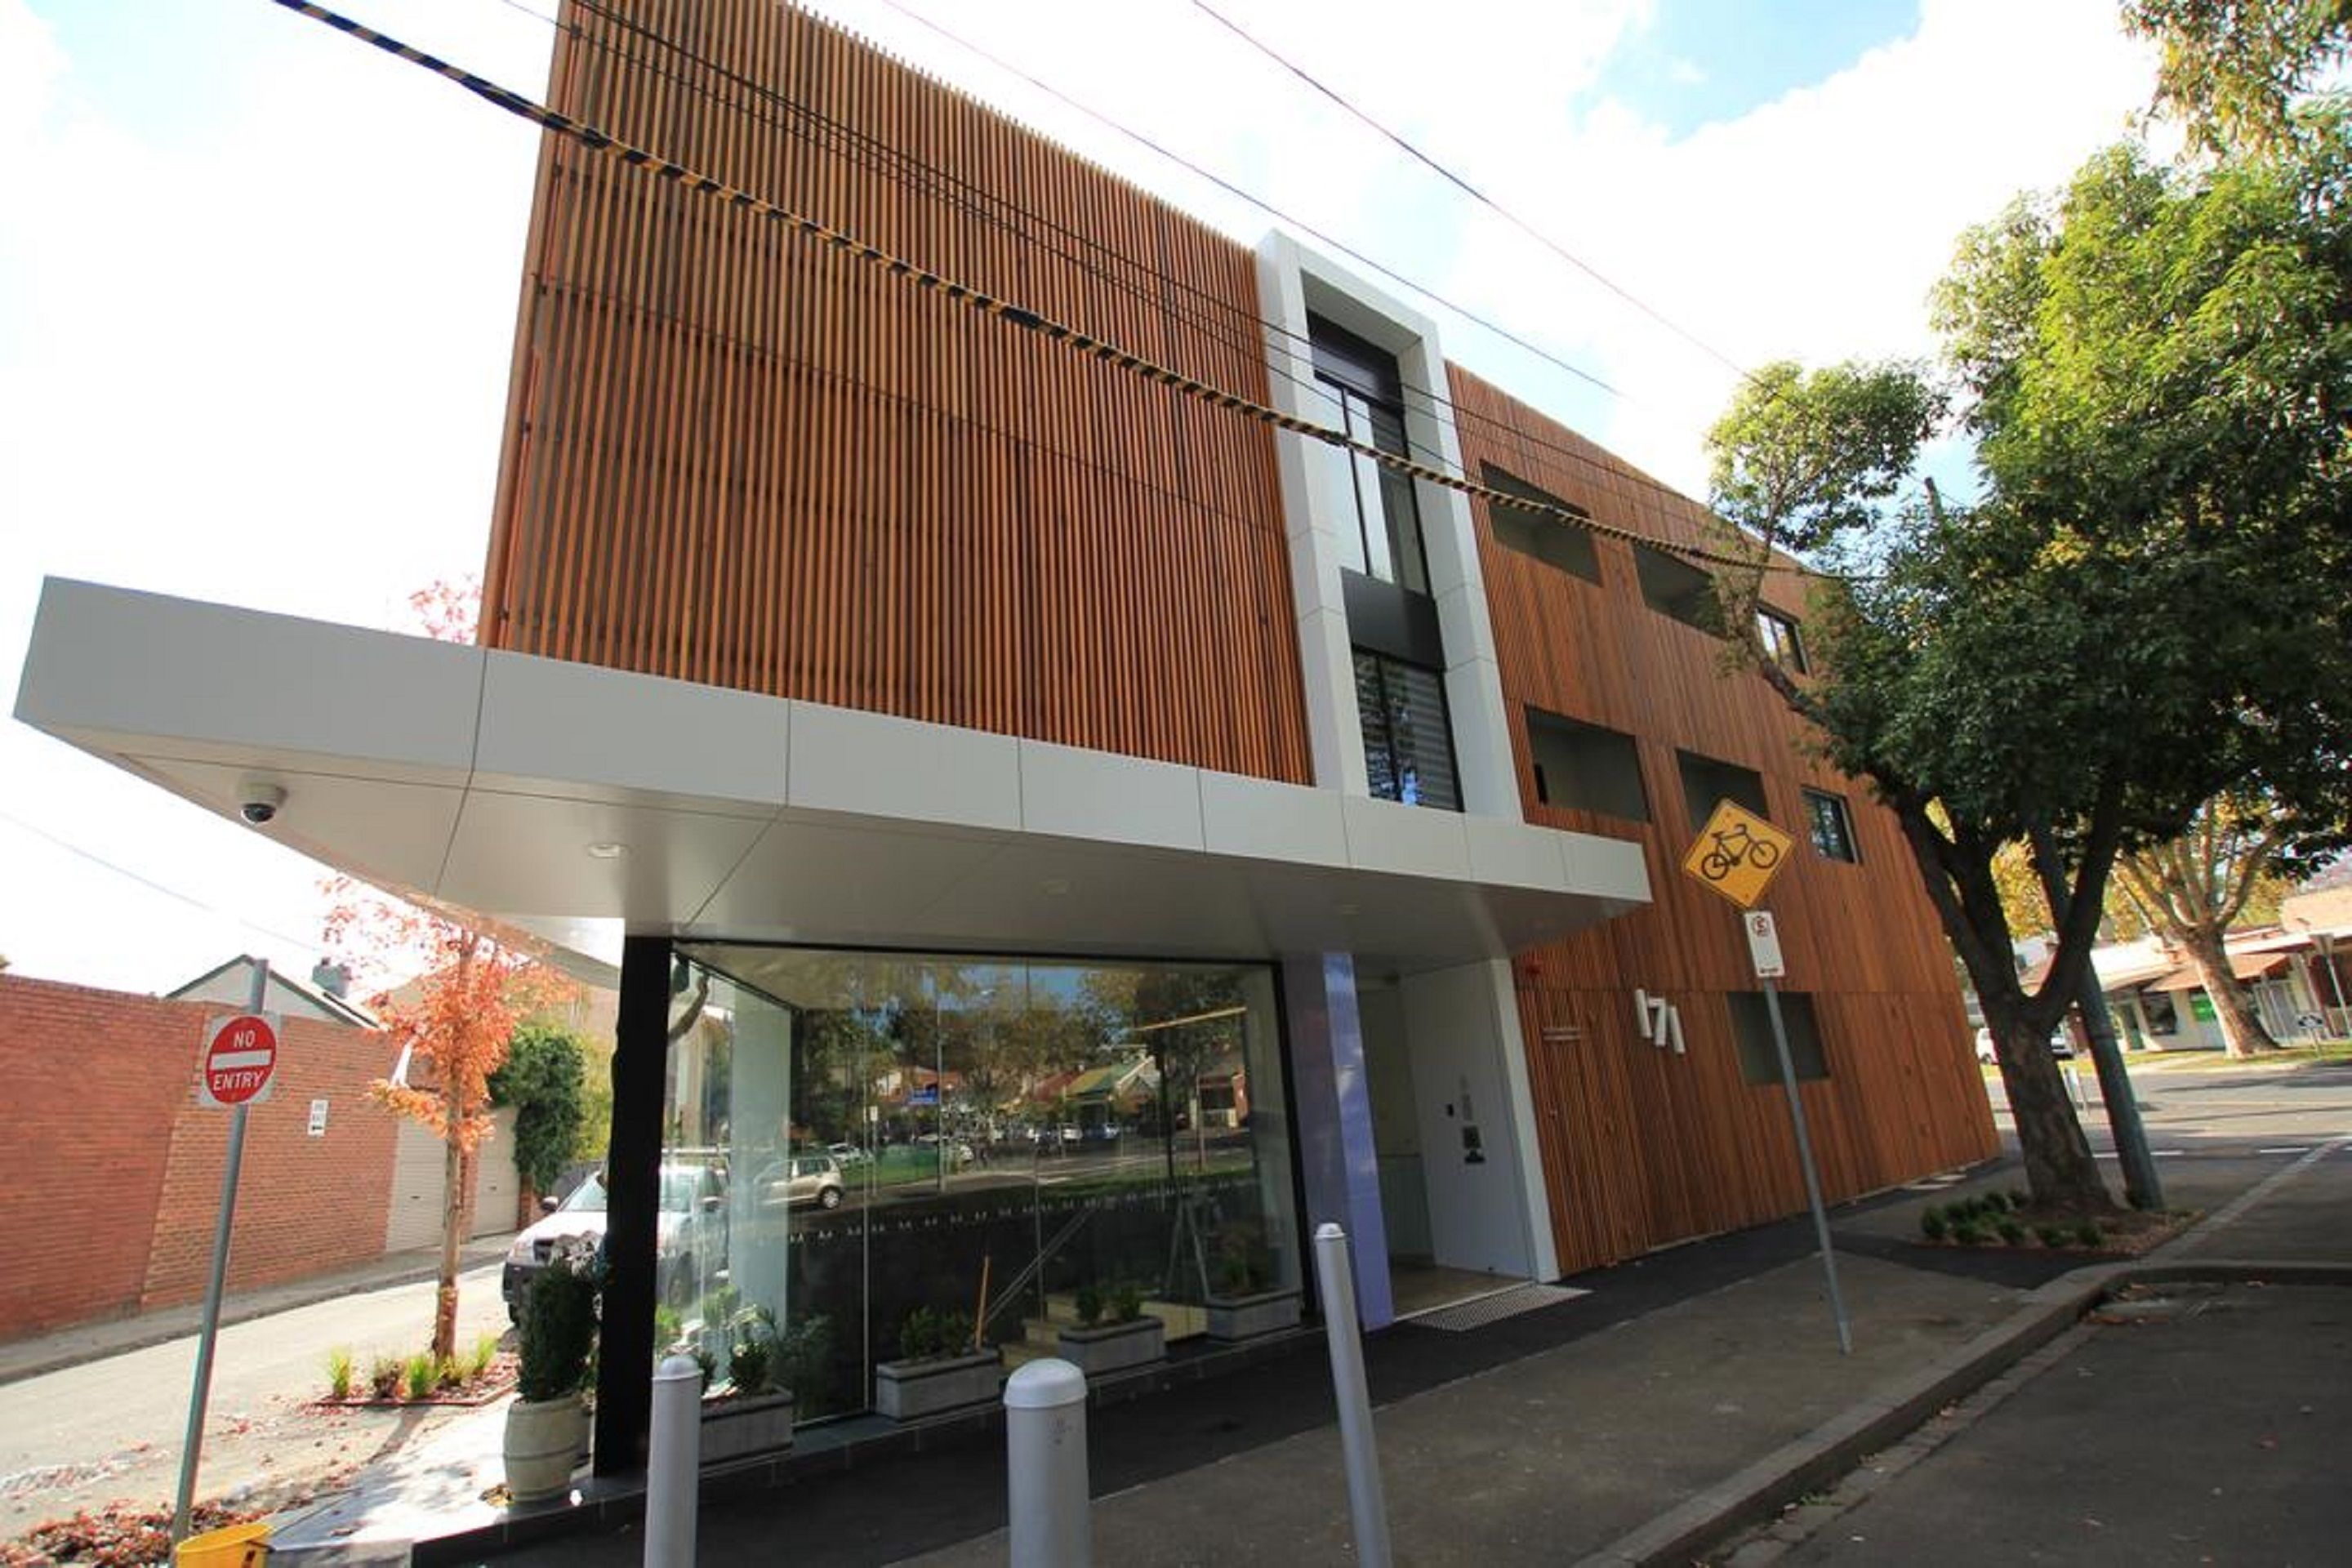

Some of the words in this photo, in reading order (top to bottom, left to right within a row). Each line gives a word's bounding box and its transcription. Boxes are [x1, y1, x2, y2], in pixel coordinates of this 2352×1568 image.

[1635, 989, 1686, 1054] 171
[234, 1031, 256, 1048] NO
[212, 1071, 264, 1091] ENTRY
